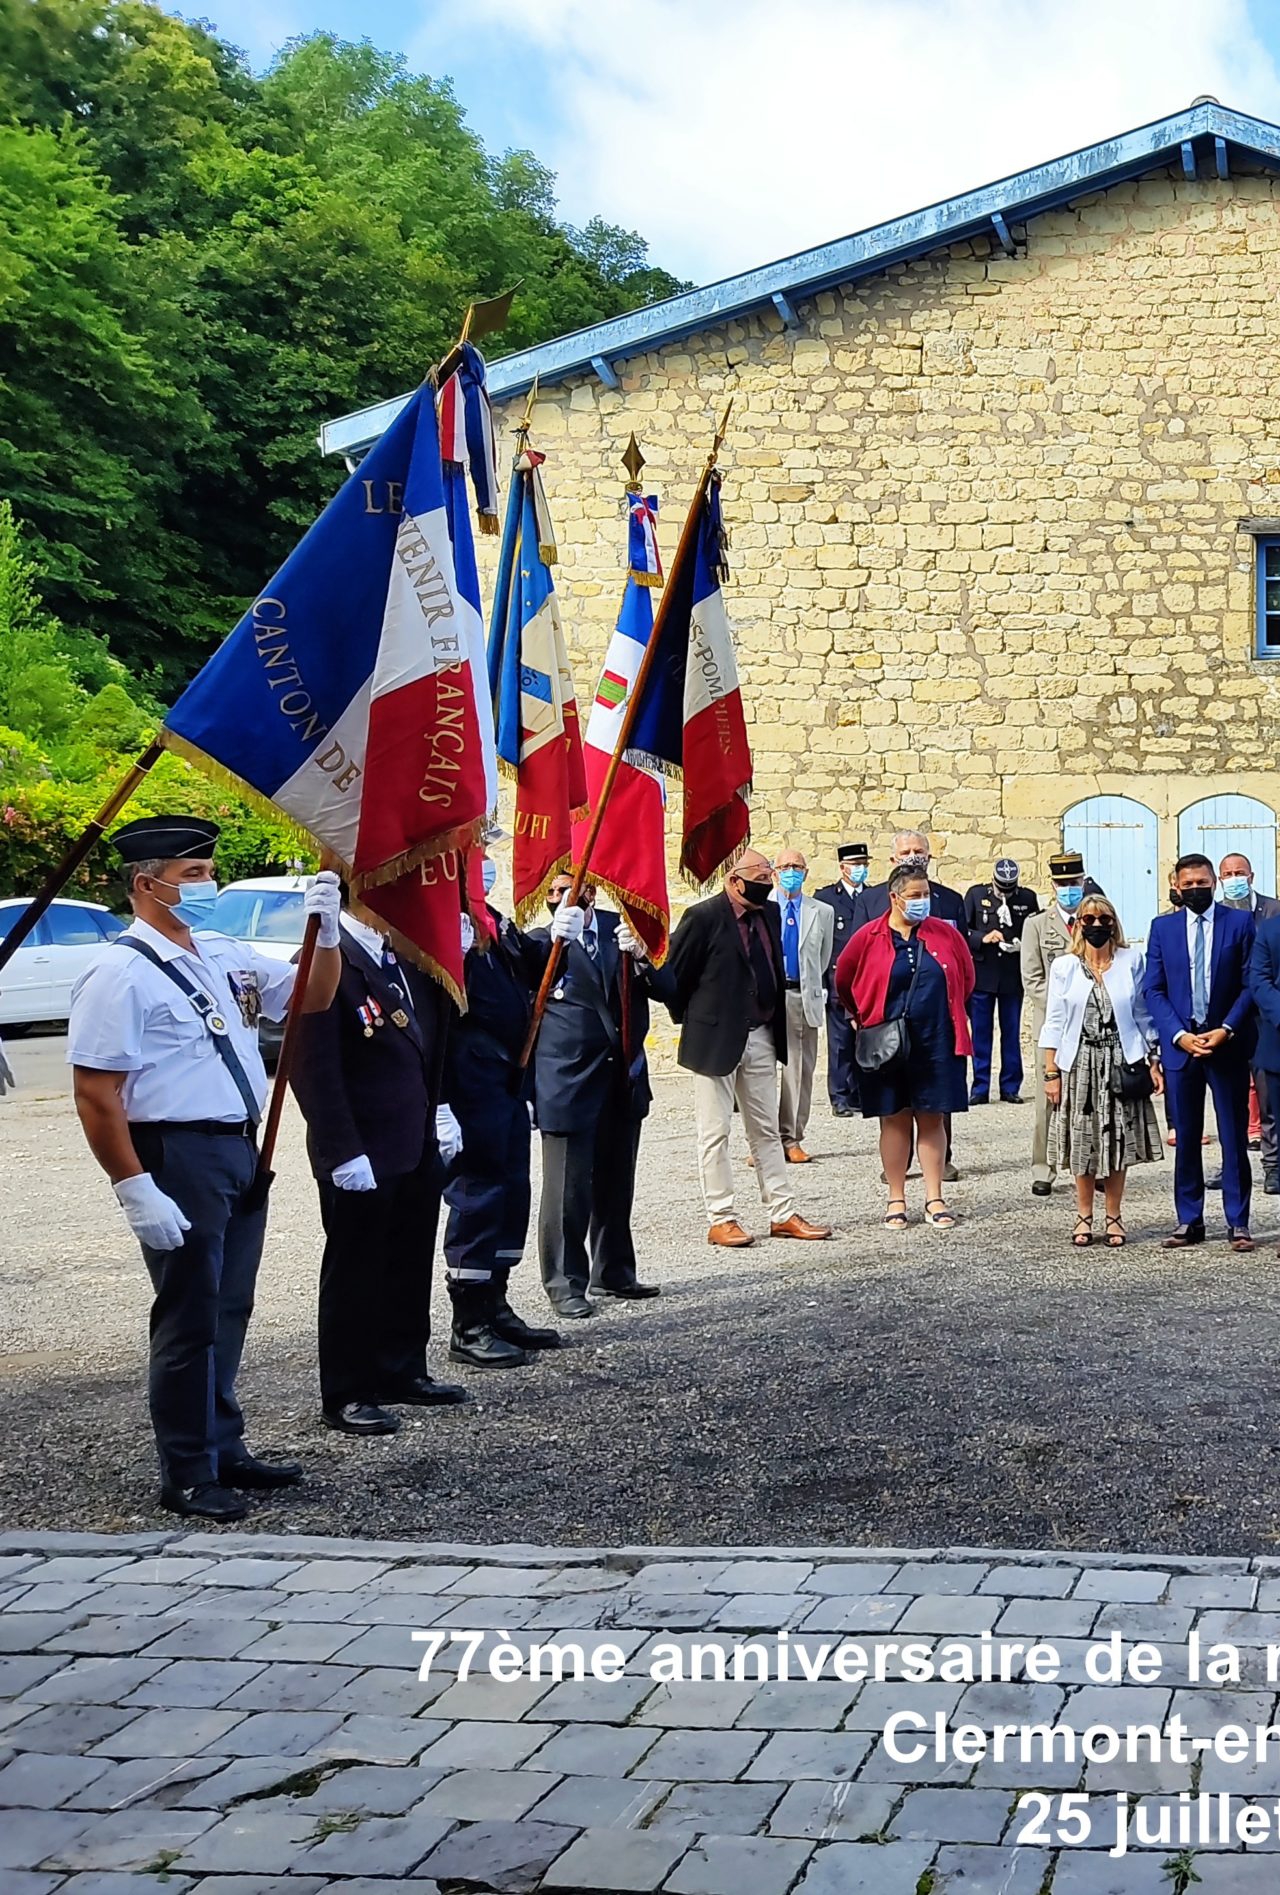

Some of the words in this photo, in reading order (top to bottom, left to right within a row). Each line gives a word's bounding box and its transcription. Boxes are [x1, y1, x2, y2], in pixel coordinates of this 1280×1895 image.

[252, 597, 328, 743] CANTON
[314, 740, 362, 794] DE
[362, 479, 405, 516] LE
[418, 633, 466, 808] FRANÇAIS
